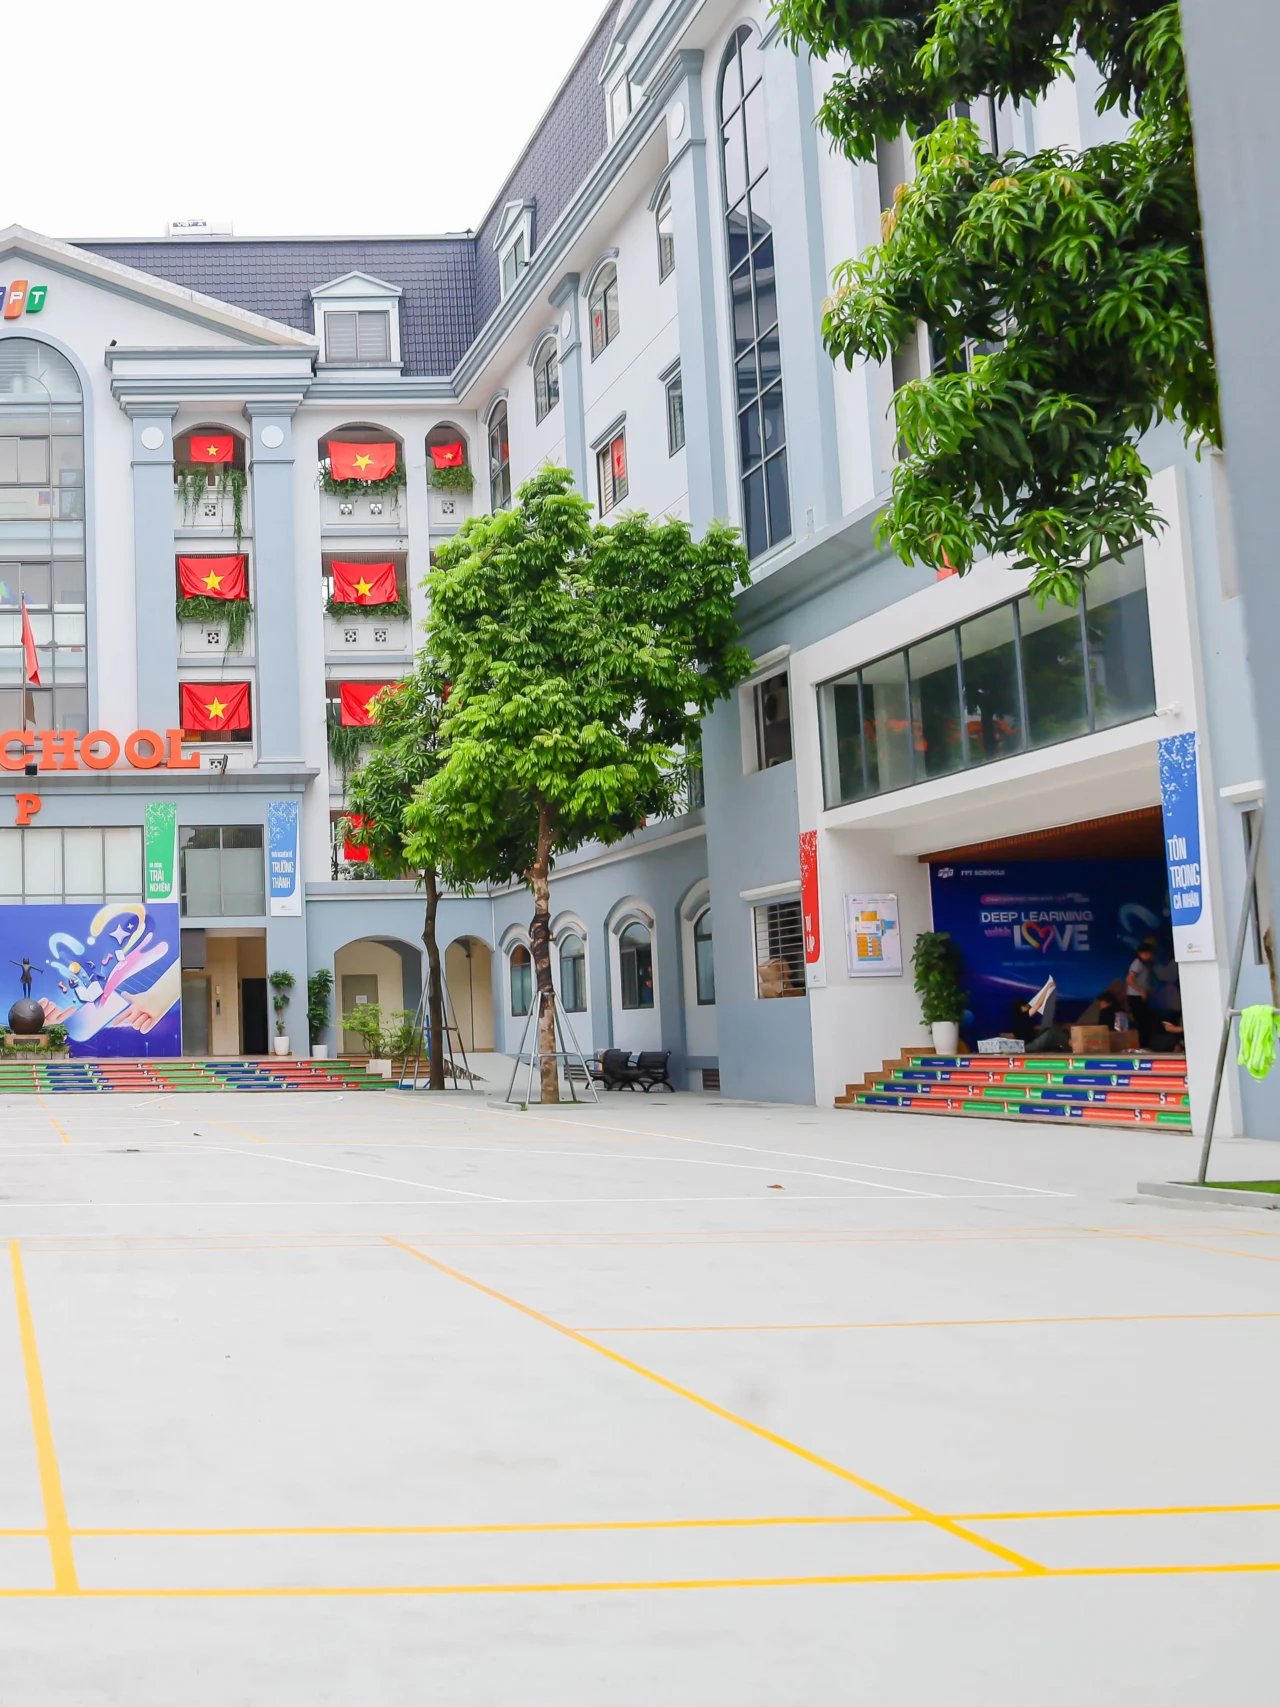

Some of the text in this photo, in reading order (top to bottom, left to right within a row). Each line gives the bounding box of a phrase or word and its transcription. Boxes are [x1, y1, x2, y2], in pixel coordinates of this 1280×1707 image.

[15, 793, 42, 825] P
[1167, 834, 1187, 861] TÔN
[272, 860, 294, 873] TRƯỞNG
[149, 868, 164, 881] TRẢI
[1170, 863, 1200, 890] TRỌNG
[150, 882, 170, 892] NGHIỆM
[272, 876, 290, 888] THÀNH
[1173, 892, 1200, 910] CÁ NHÂN
[981, 911, 1093, 922] DEEP LEARNING
[985, 925, 1012, 937] with
